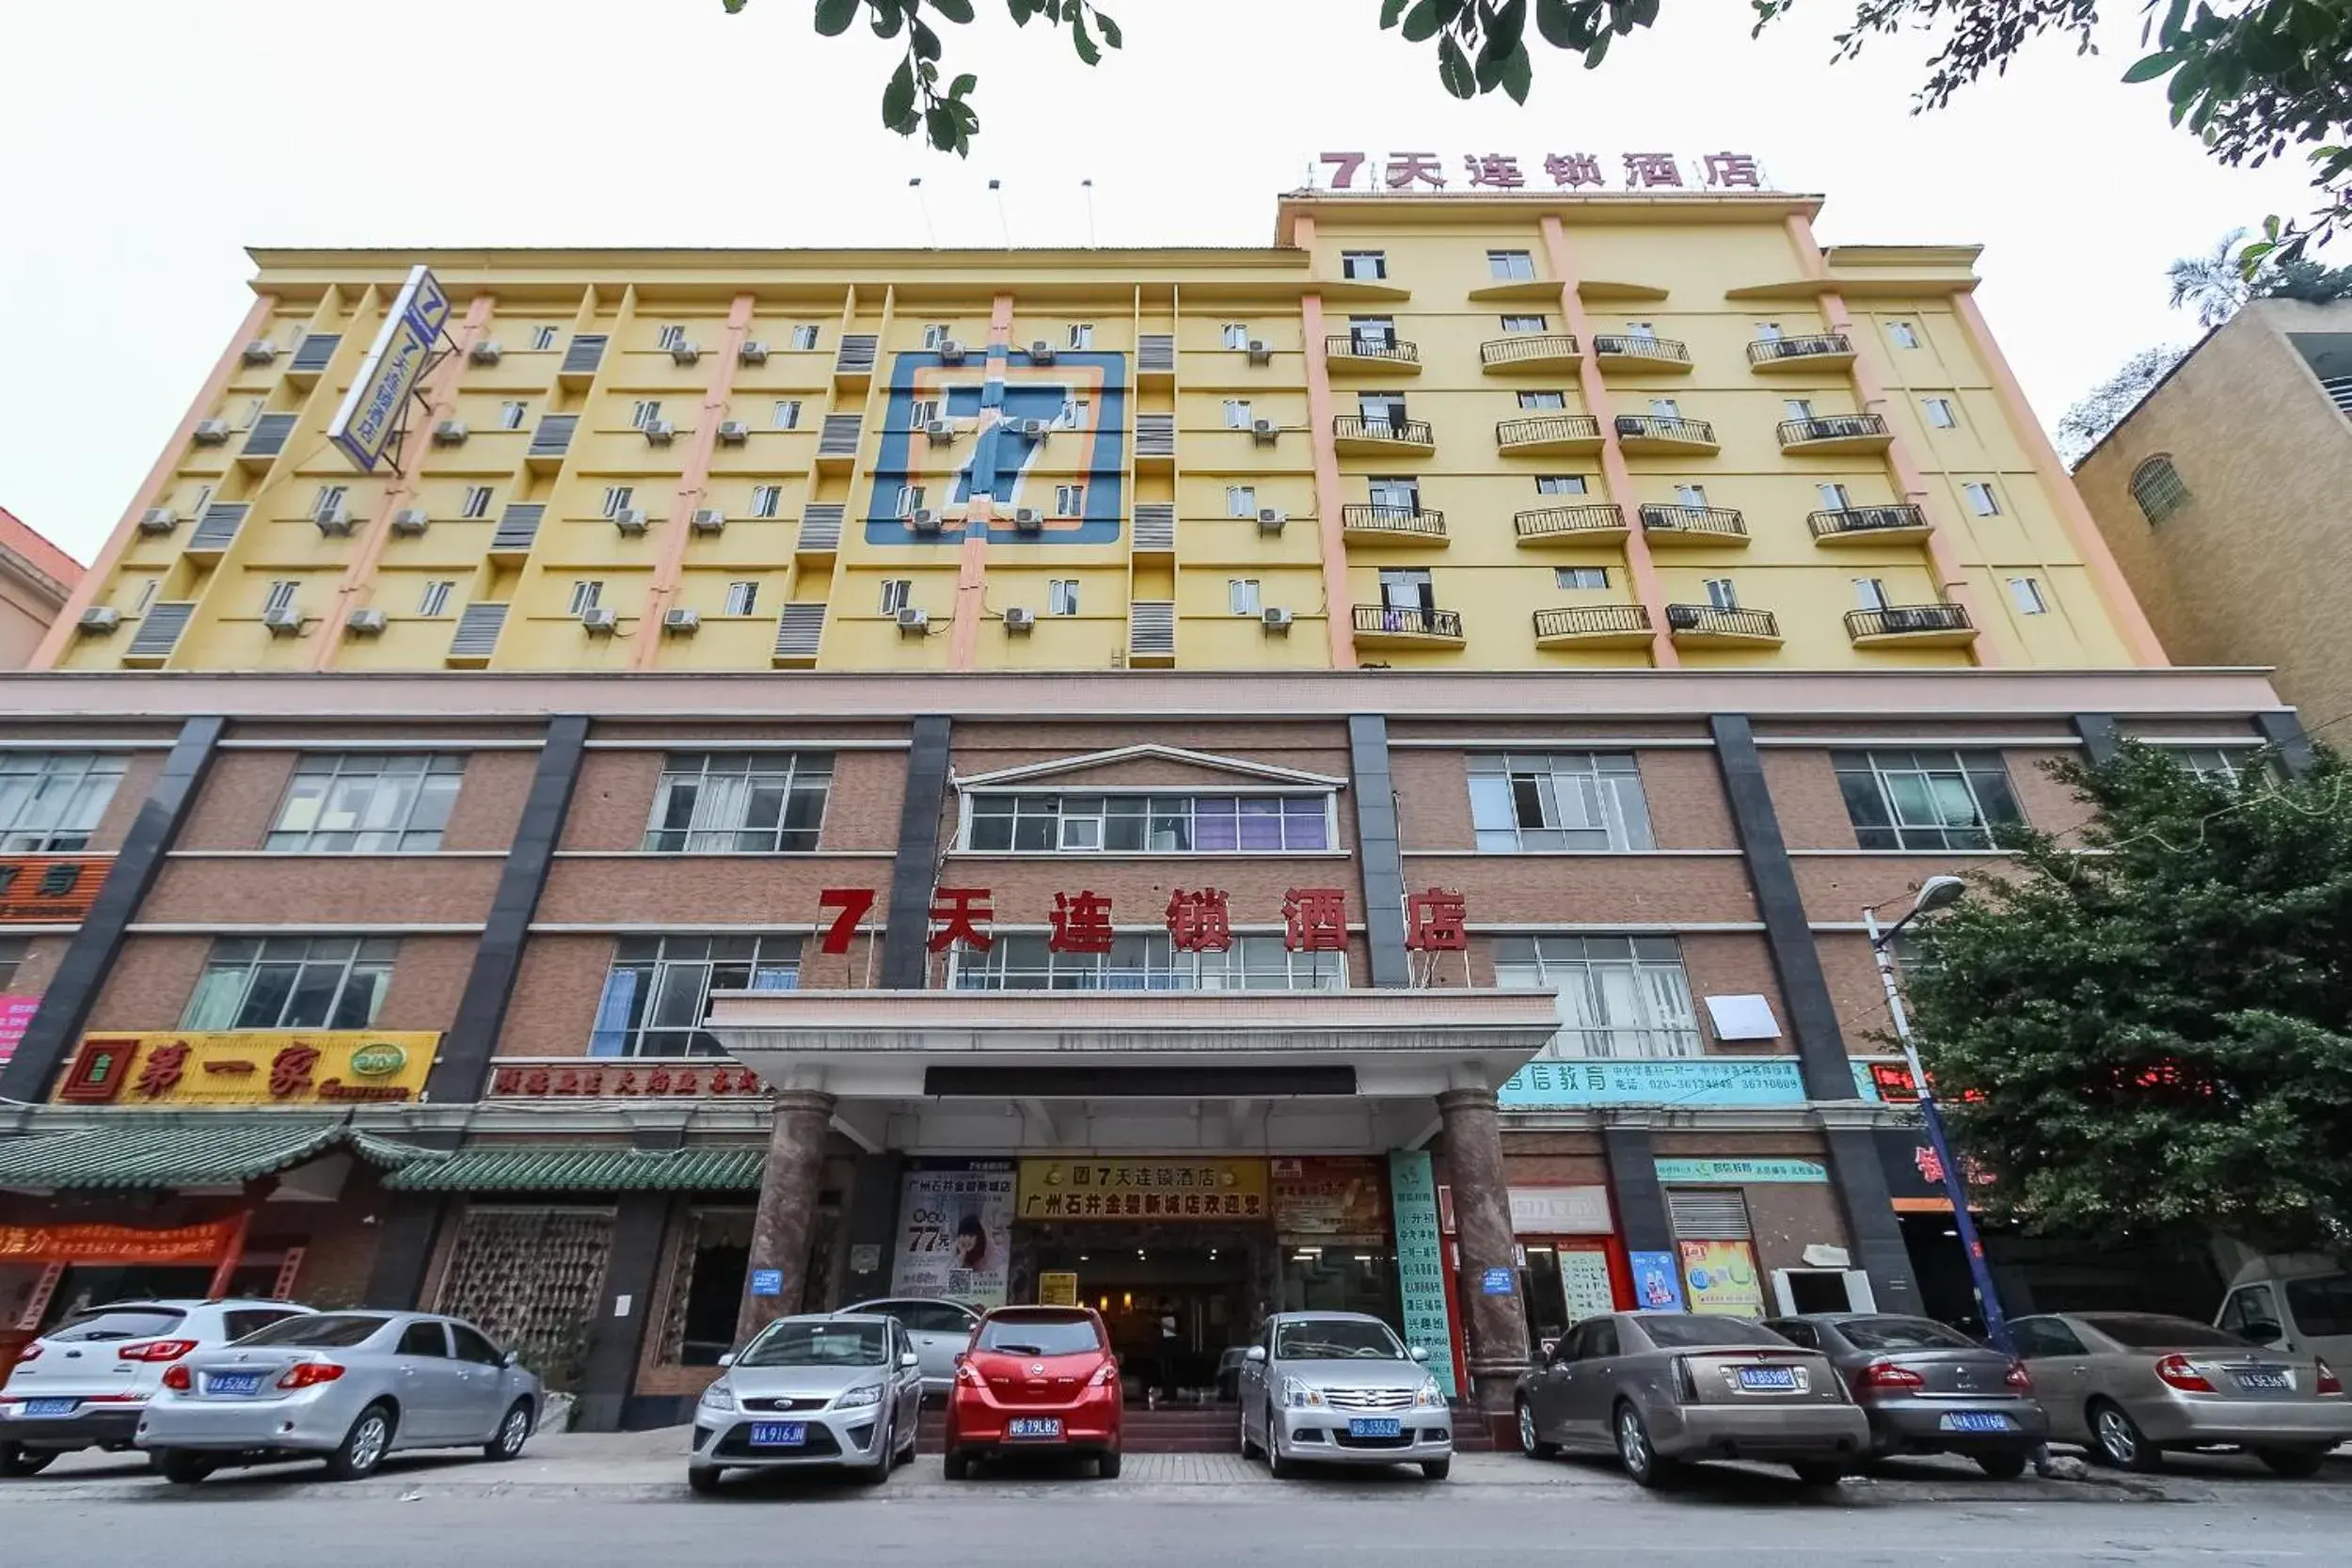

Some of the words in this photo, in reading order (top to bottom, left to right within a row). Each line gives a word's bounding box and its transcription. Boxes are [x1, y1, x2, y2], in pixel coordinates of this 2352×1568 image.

[1320, 151, 1759, 188] 7天连锁酒店
[819, 888, 1467, 954] 7天连锁酒店
[132, 1038, 322, 1099] 第一家
[1097, 1166, 1216, 1187] 7天连锁酒店
[1025, 1193, 1262, 1215] 广州石井金碧新城店欢迎您
